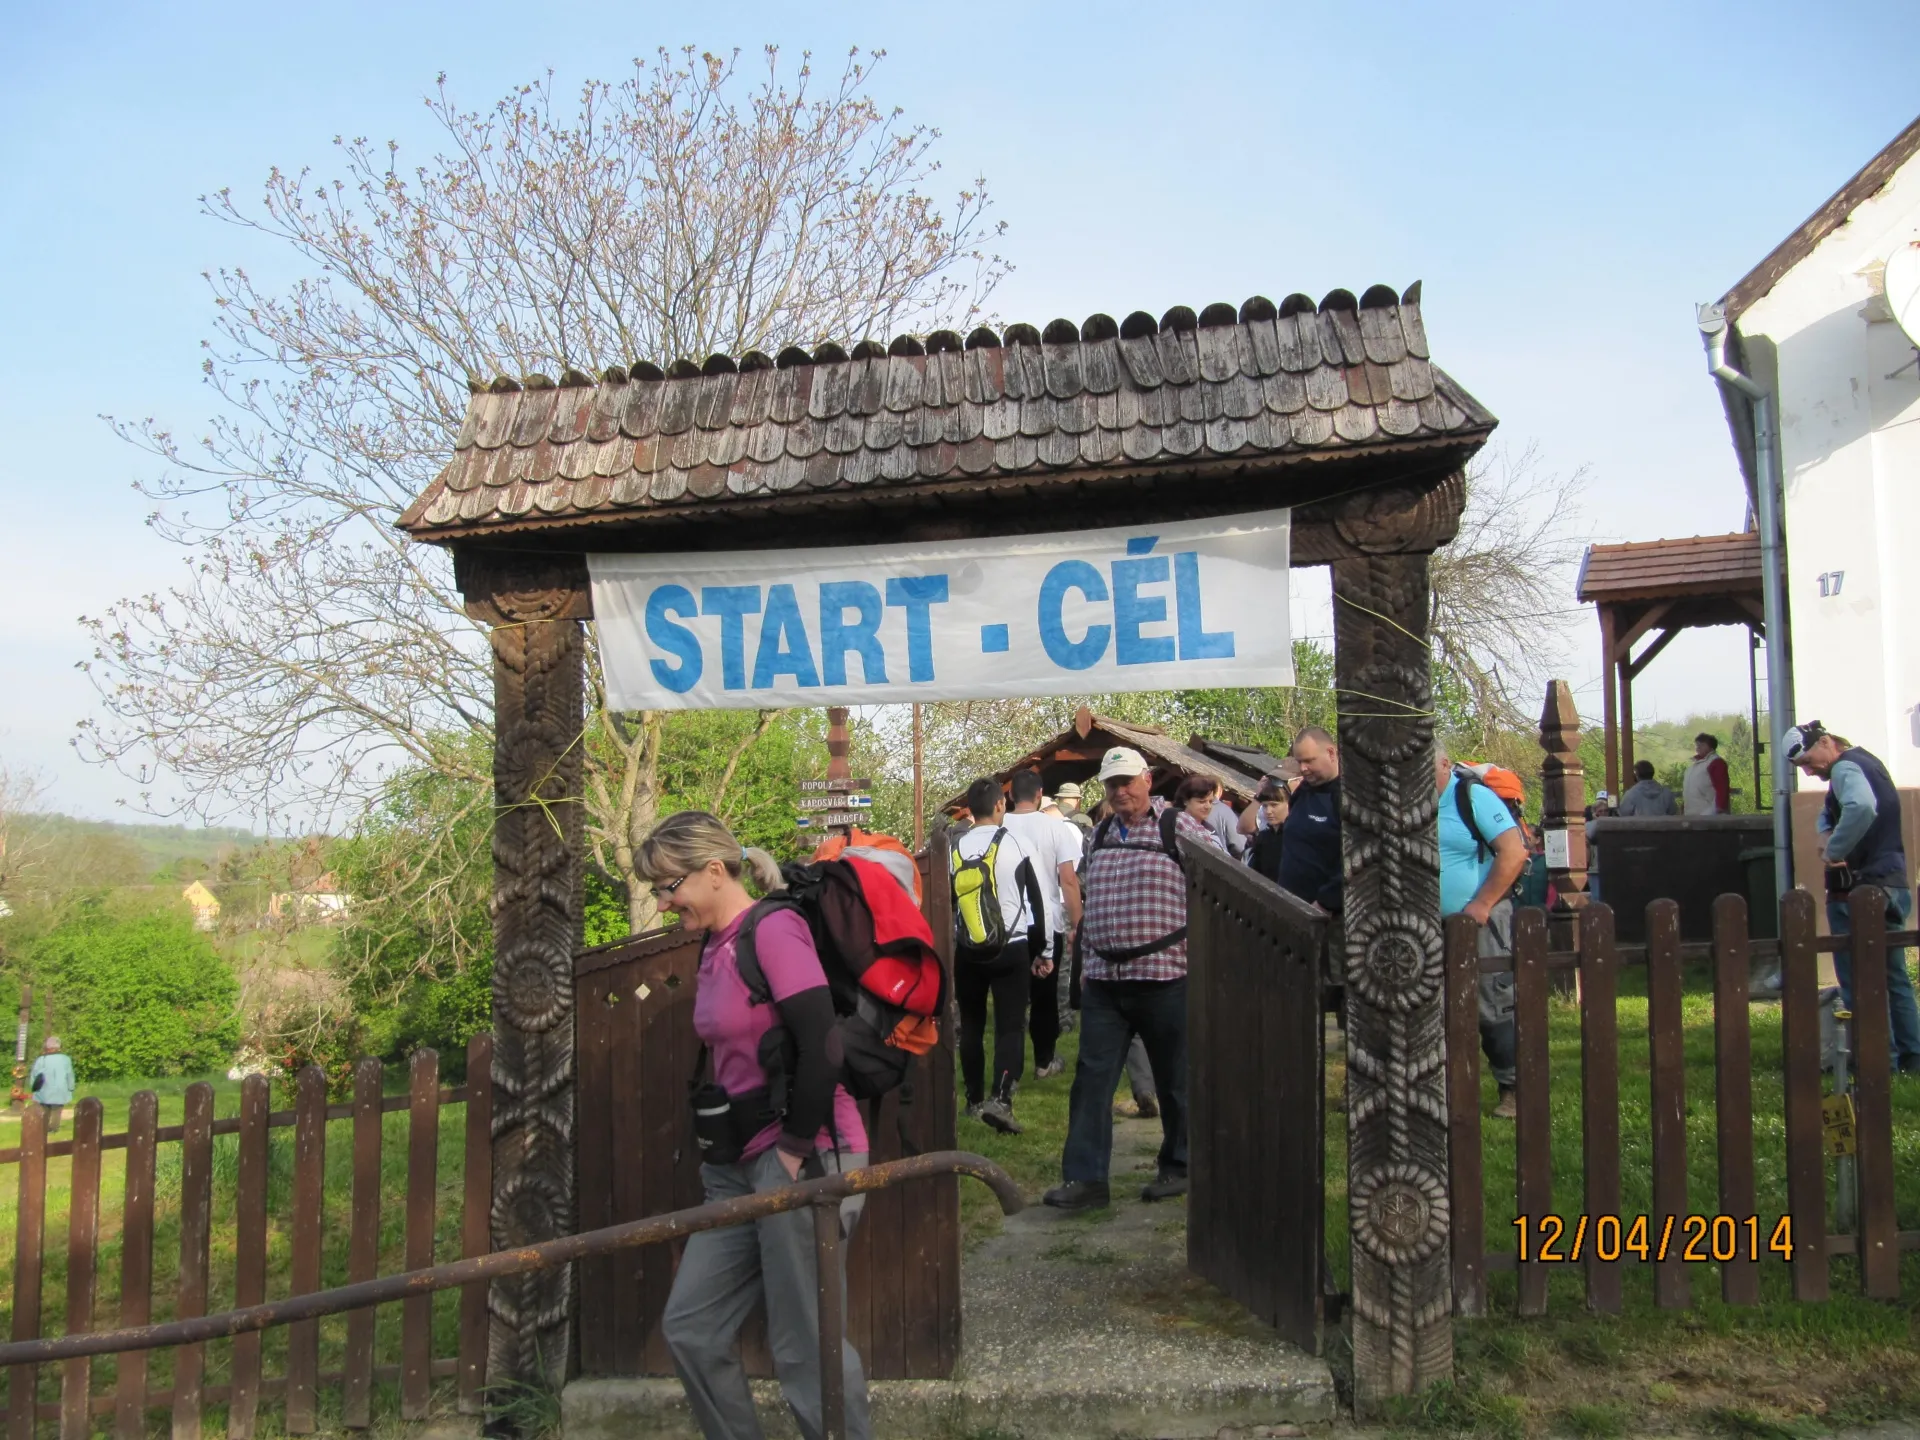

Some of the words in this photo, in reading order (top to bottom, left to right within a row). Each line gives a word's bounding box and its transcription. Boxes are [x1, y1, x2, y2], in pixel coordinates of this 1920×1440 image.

[645, 574, 949, 694] START
[1038, 536, 1236, 671] CÉL
[1816, 570, 1845, 598] 17
